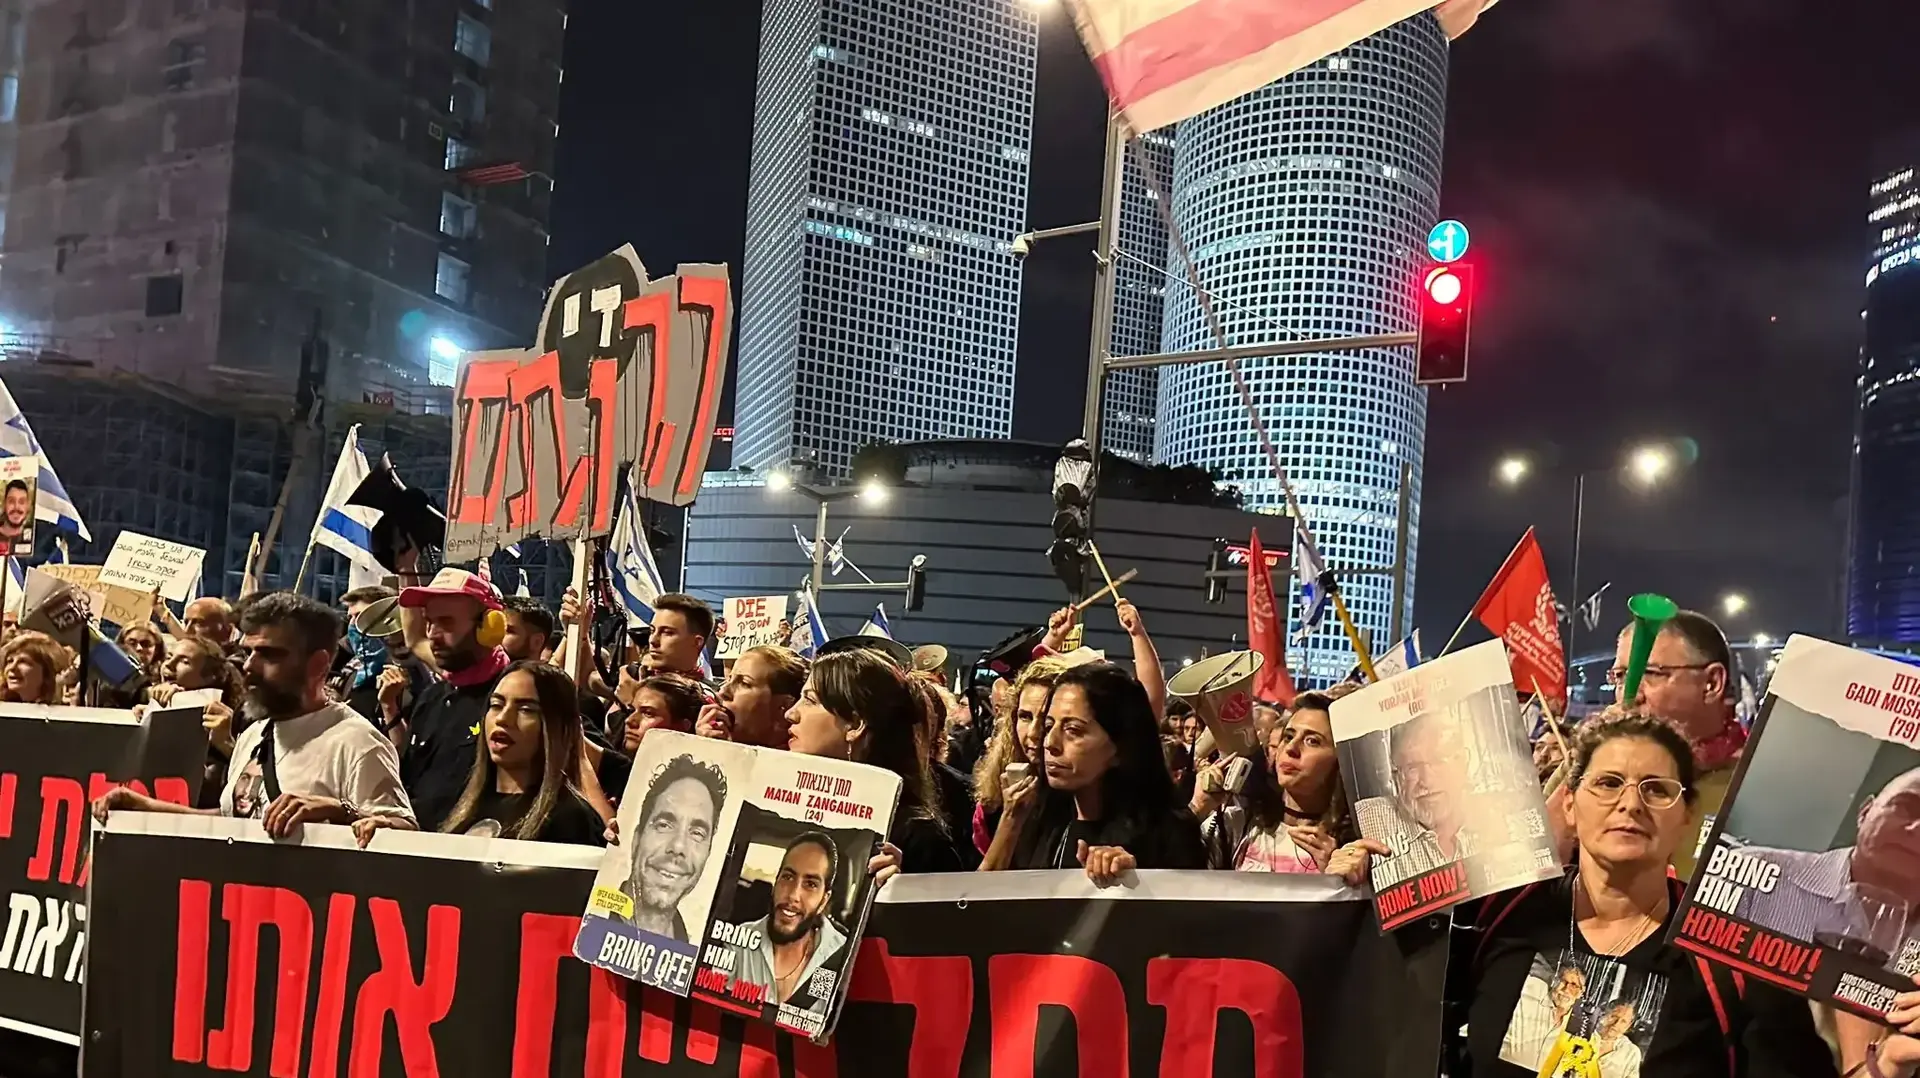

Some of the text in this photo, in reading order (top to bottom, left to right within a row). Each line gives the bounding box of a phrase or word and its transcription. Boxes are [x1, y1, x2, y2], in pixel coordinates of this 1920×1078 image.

[736, 598, 767, 618] DIE
[718, 636, 746, 655] STOP
[1845, 682, 1881, 707] GADI
[796, 770, 852, 797] מתן צנגאוקר
[764, 786, 874, 820] MATAN ZANGAUKER
[805, 809, 824, 823] (24)
[1706, 843, 1781, 895] BRING
[1377, 881, 1418, 920] HOME
[1418, 860, 1468, 902] NOW!
[1693, 874, 1744, 916] HIM
[711, 919, 762, 950] BRING
[1680, 906, 1822, 982] HOME NOW!
[599, 931, 655, 975] BRING
[702, 945, 735, 971] HIM
[172, 879, 463, 1078] אותו
[695, 967, 769, 1009] HOME NOW!
[1840, 972, 1881, 994] HOSTAGES
[1834, 983, 1886, 1010] FAMILIES
[776, 1011, 802, 1029] FAMILIES
